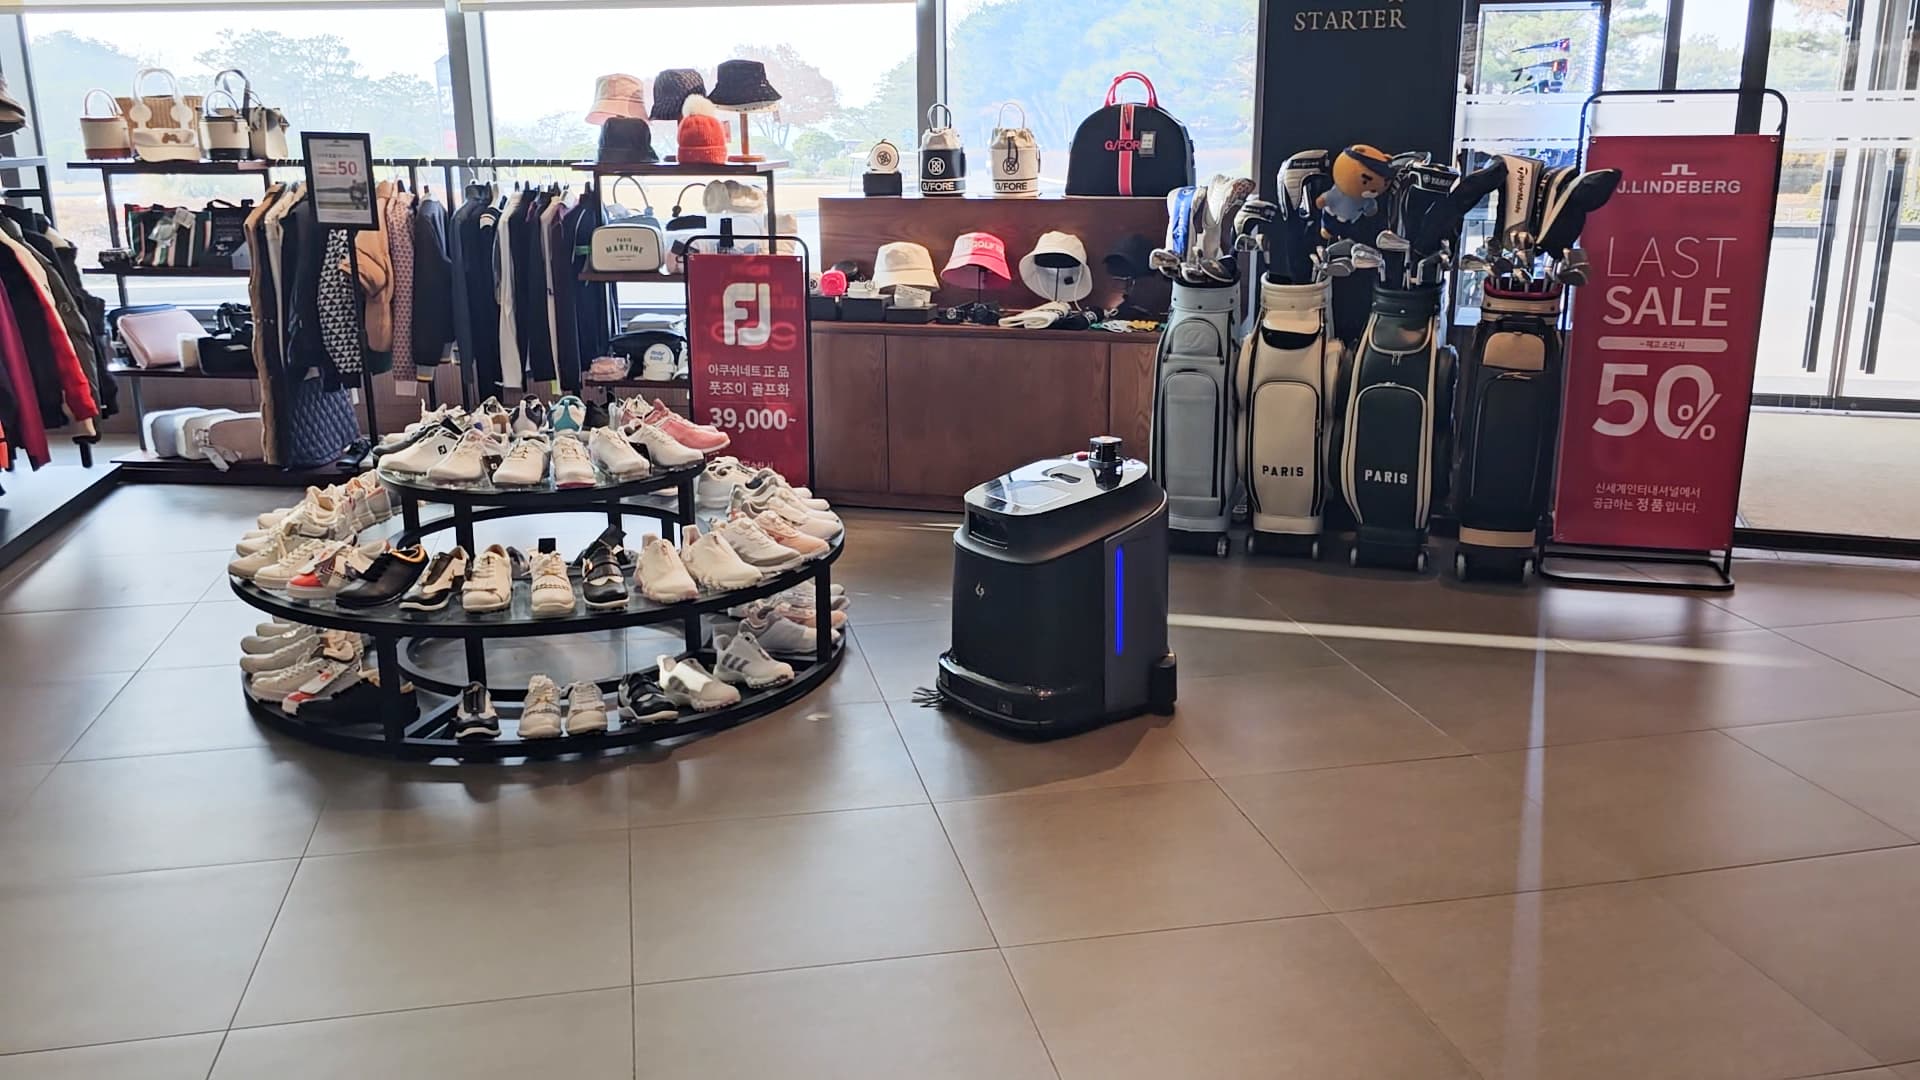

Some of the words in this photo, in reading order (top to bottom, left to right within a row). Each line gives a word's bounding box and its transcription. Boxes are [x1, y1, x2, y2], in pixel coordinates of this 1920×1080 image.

[1294, 8, 1407, 31] STARTER
[1104, 140, 1141, 150] G/FOR
[338, 161, 358, 175] 50
[922, 180, 955, 191] G/FORE
[995, 182, 1028, 191] G/FORE
[1616, 180, 1741, 194] J.LINDEBERG
[606, 244, 644, 254] MARTINE
[1607, 236, 1738, 279] LAST
[1603, 285, 1731, 327] SALE
[722, 282, 772, 347] FJ
[708, 363, 761, 377] 아쿠쉬네트
[709, 380, 747, 396] 풋조이
[752, 382, 790, 398] 골프화
[1592, 362, 1722, 441] 50%
[1262, 465, 1304, 477] PARIS
[1364, 469, 1408, 485] PARIS
[1593, 497, 1634, 511] 공급하는
